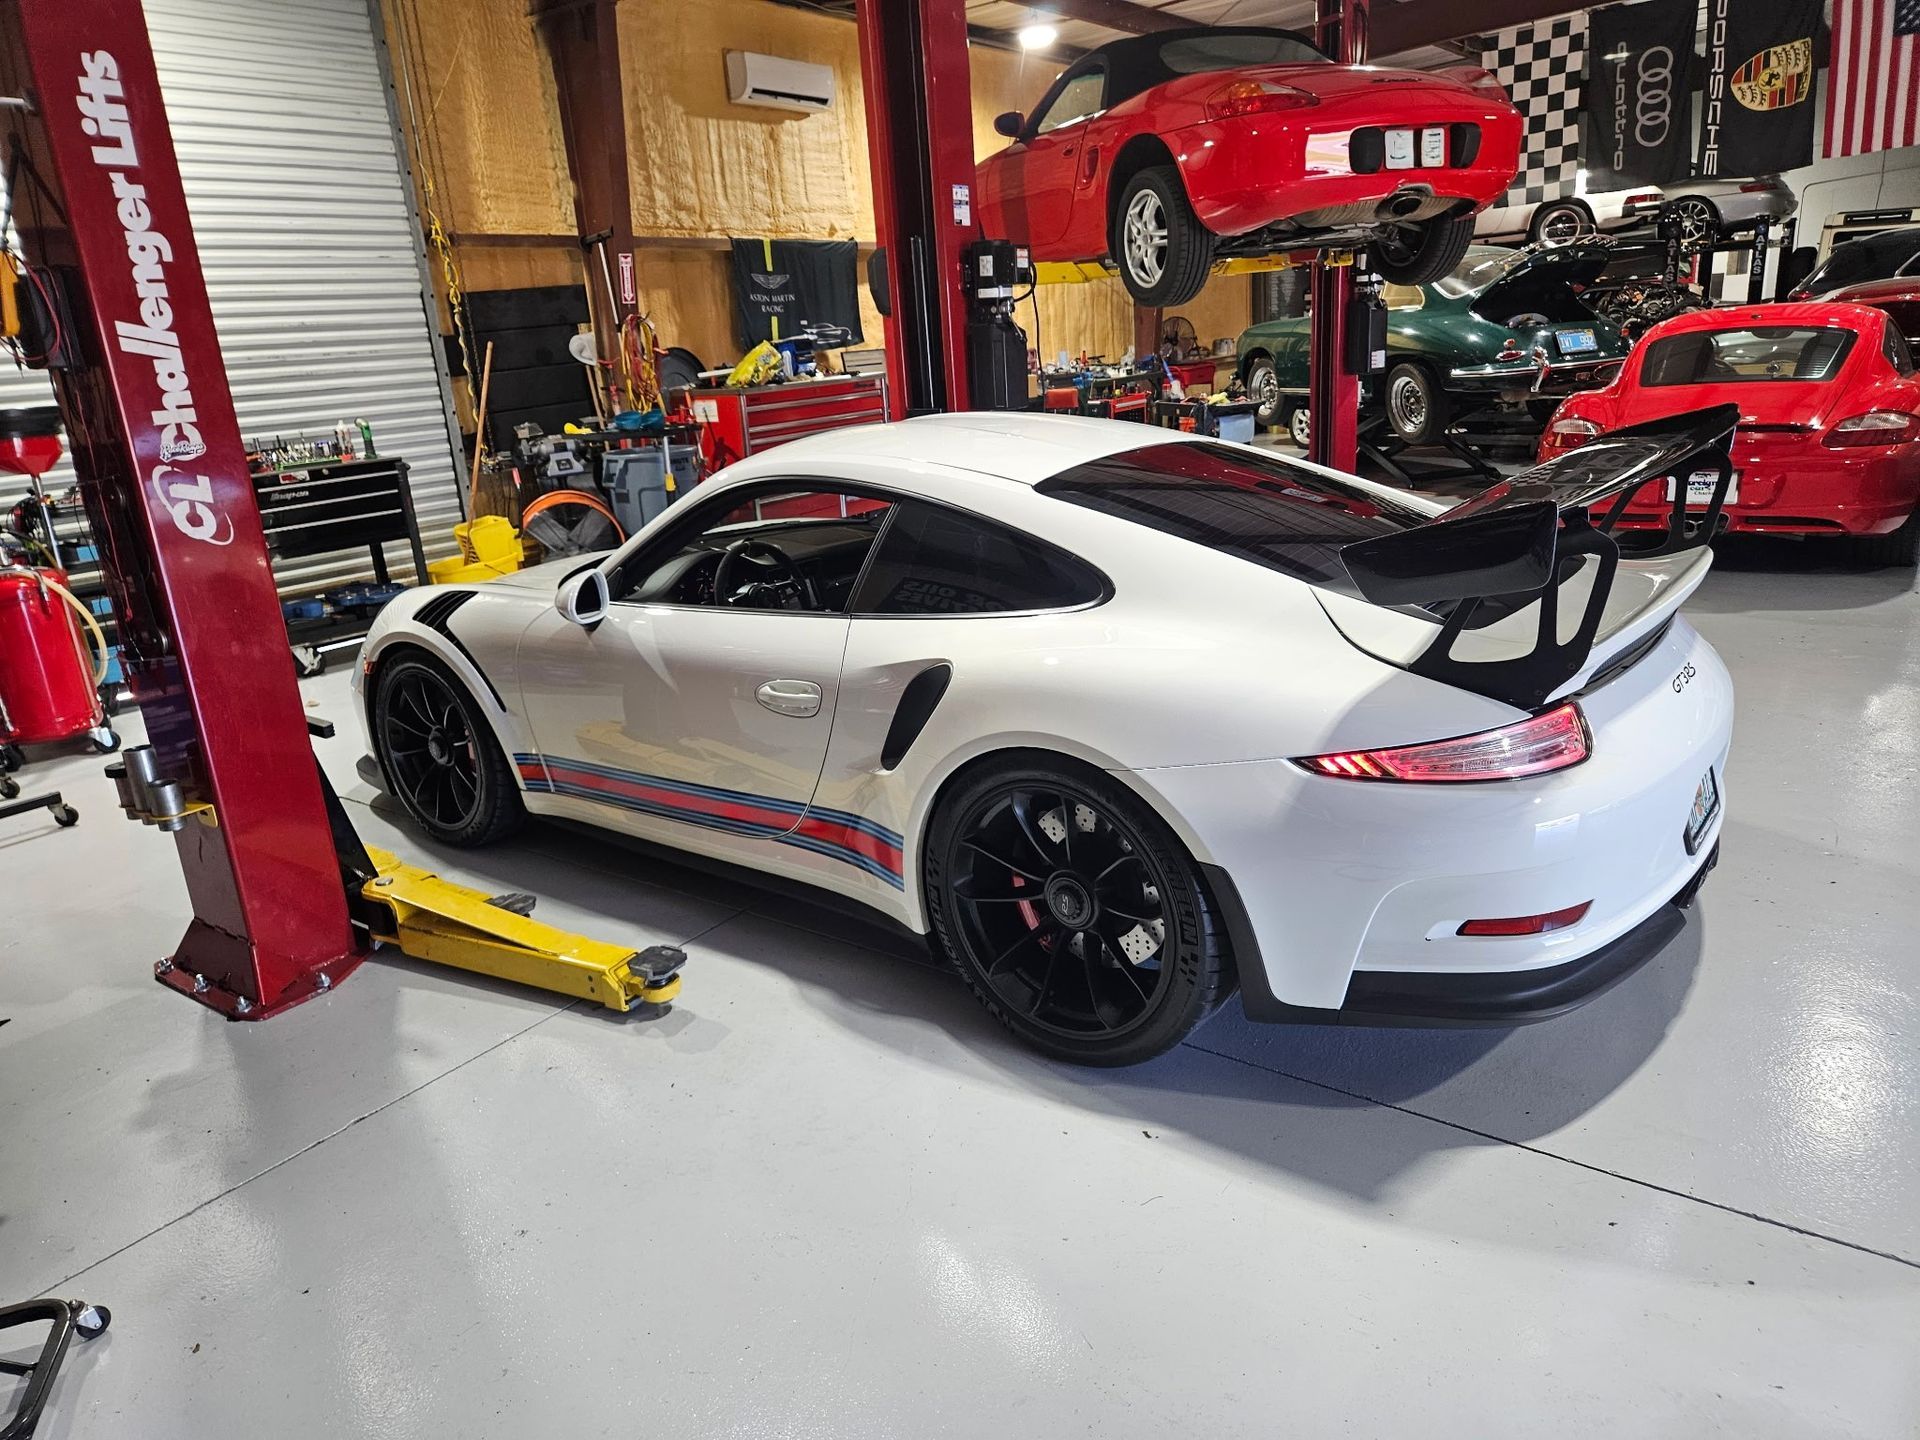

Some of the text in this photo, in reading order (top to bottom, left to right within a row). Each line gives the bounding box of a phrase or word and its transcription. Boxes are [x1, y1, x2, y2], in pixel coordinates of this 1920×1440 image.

[76, 50, 139, 166] Lifts
[1614, 41, 1627, 171] quattro
[1703, 0, 1728, 175] PORSCHE
[1665, 239, 1677, 282] ATLAS
[1753, 235, 1765, 274] ATLAS
[108, 172, 204, 460] Challenger
[750, 294, 796, 303] ASTON MARTIN
[761, 305, 785, 313] RACING
